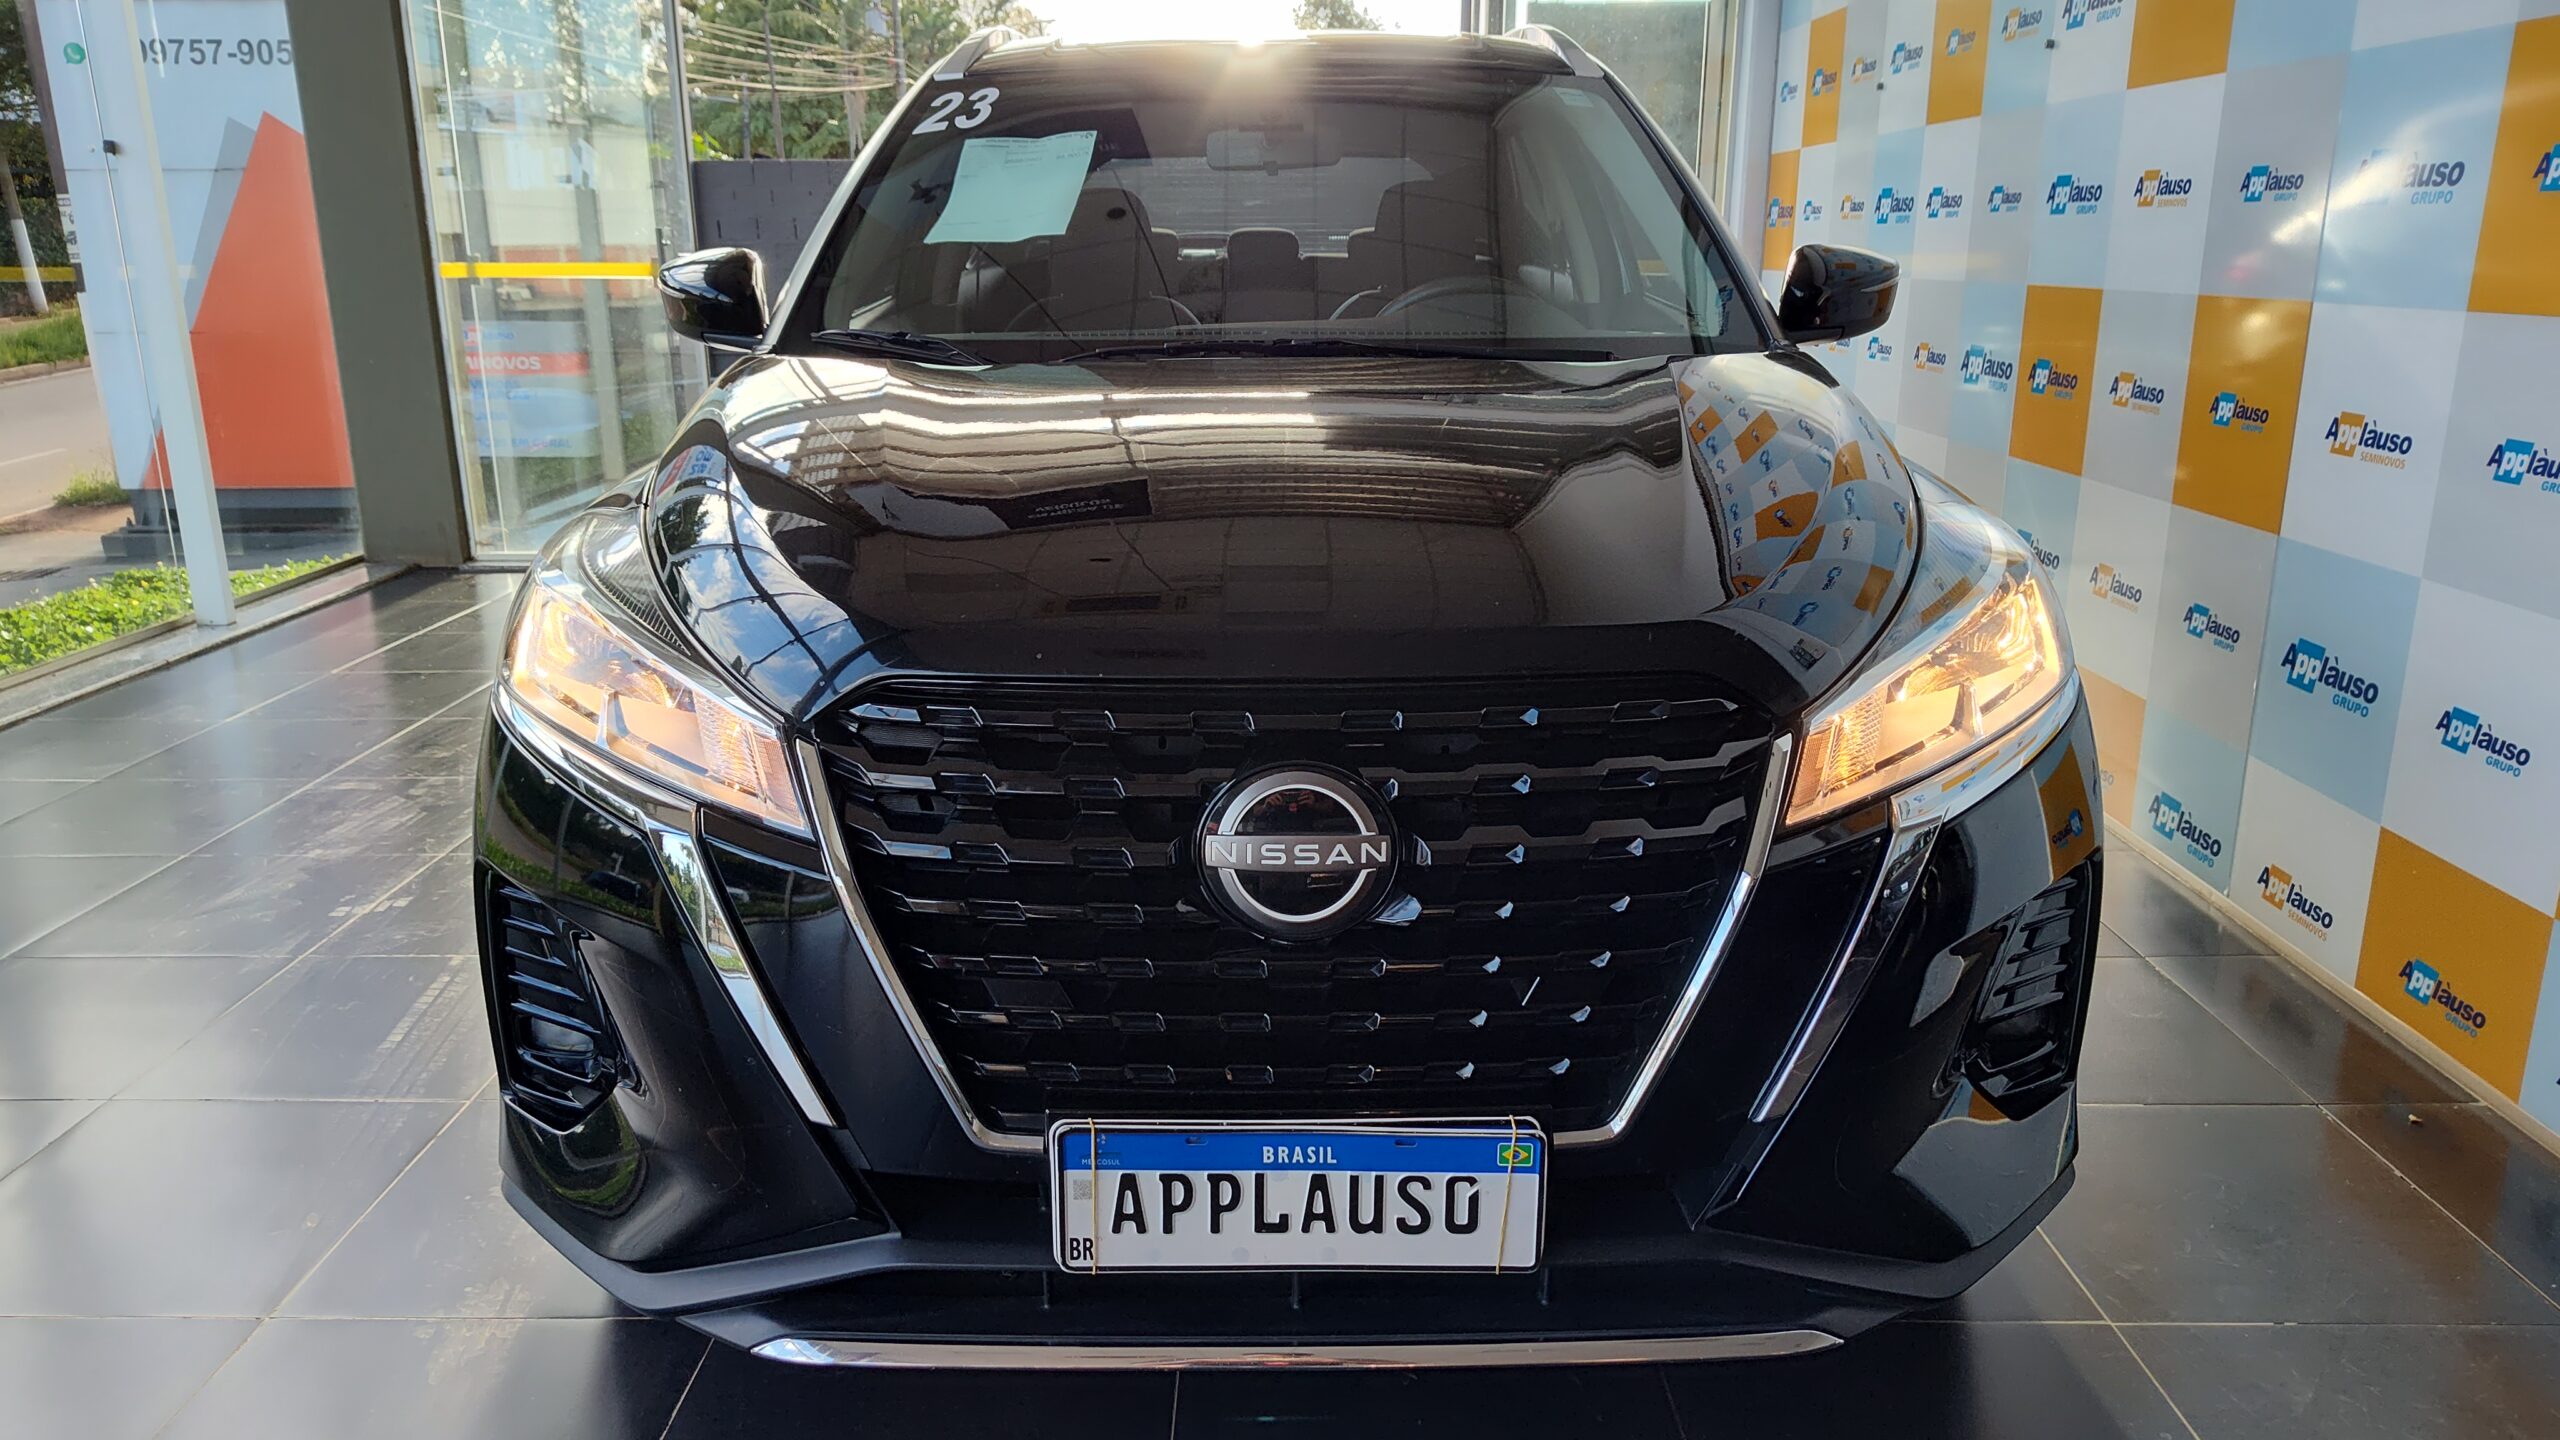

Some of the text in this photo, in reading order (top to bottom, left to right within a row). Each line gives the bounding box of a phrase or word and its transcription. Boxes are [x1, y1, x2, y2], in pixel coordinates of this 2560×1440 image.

[139, 39, 293, 66] 9757-905
[911, 87, 1000, 136] 23
[2410, 190, 2454, 206] GRUPO
[2359, 450, 2406, 470] SEMINOVOS
[2332, 693, 2369, 718] GRUPO
[2485, 755, 2521, 777] GRUPO
[1210, 840, 1388, 866] NISSAN
[2186, 843, 2214, 868] GRUPO
[2287, 909, 2328, 942] SEMINOVOS
[2444, 1012, 2478, 1039] GRUPO
[1081, 1158, 1121, 1166] MECOSUL
[1262, 1145, 1338, 1165] BRASIL
[1111, 1173, 1481, 1235] APPLAUSO
[1069, 1237, 1094, 1261] BR
